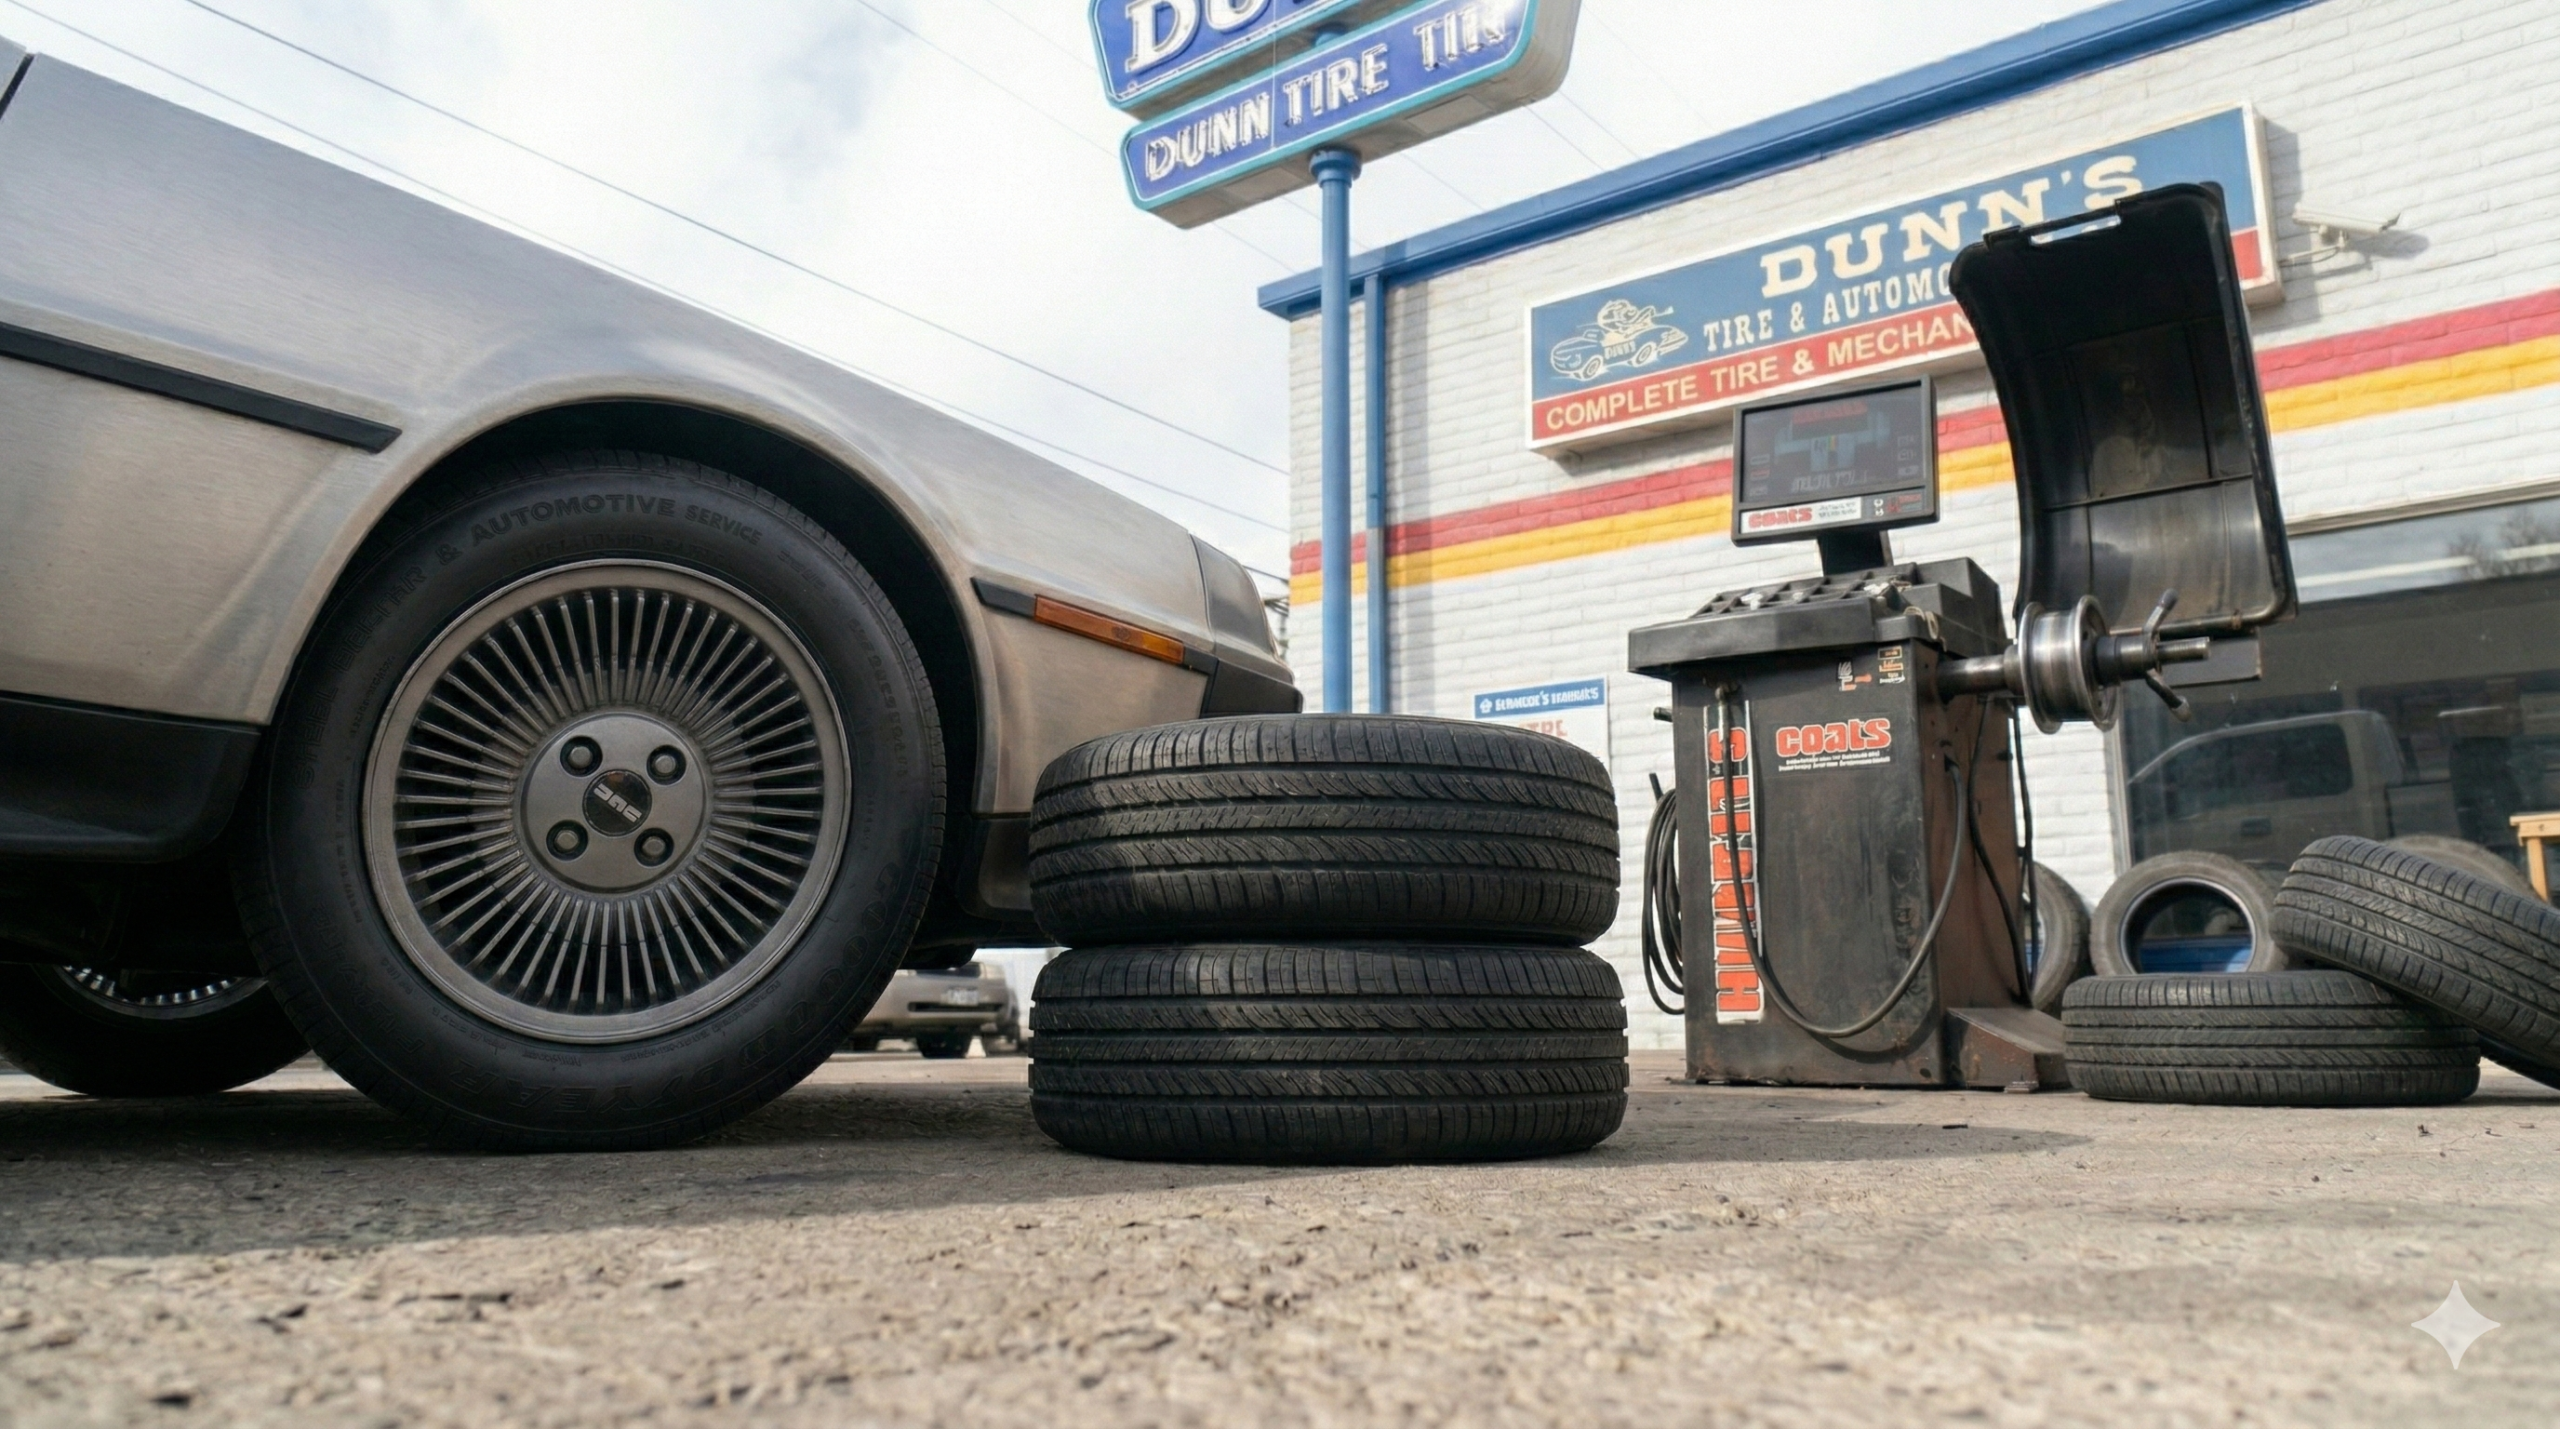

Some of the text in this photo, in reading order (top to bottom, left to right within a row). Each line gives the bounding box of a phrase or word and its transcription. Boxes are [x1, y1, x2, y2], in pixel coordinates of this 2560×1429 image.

[1144, 91, 1270, 181] DUNN
[1283, 43, 1388, 126] TIRE
[1759, 155, 2143, 298] DUNN'S
[1704, 310, 1774, 353] TIRE
[1790, 302, 1806, 329] &
[1546, 375, 1698, 431] COMPLETE
[1709, 356, 1778, 398] TIRE
[1792, 347, 1814, 376] &
[470, 494, 677, 547] AUTOMOTIVE
[685, 504, 763, 546] SERVICE
